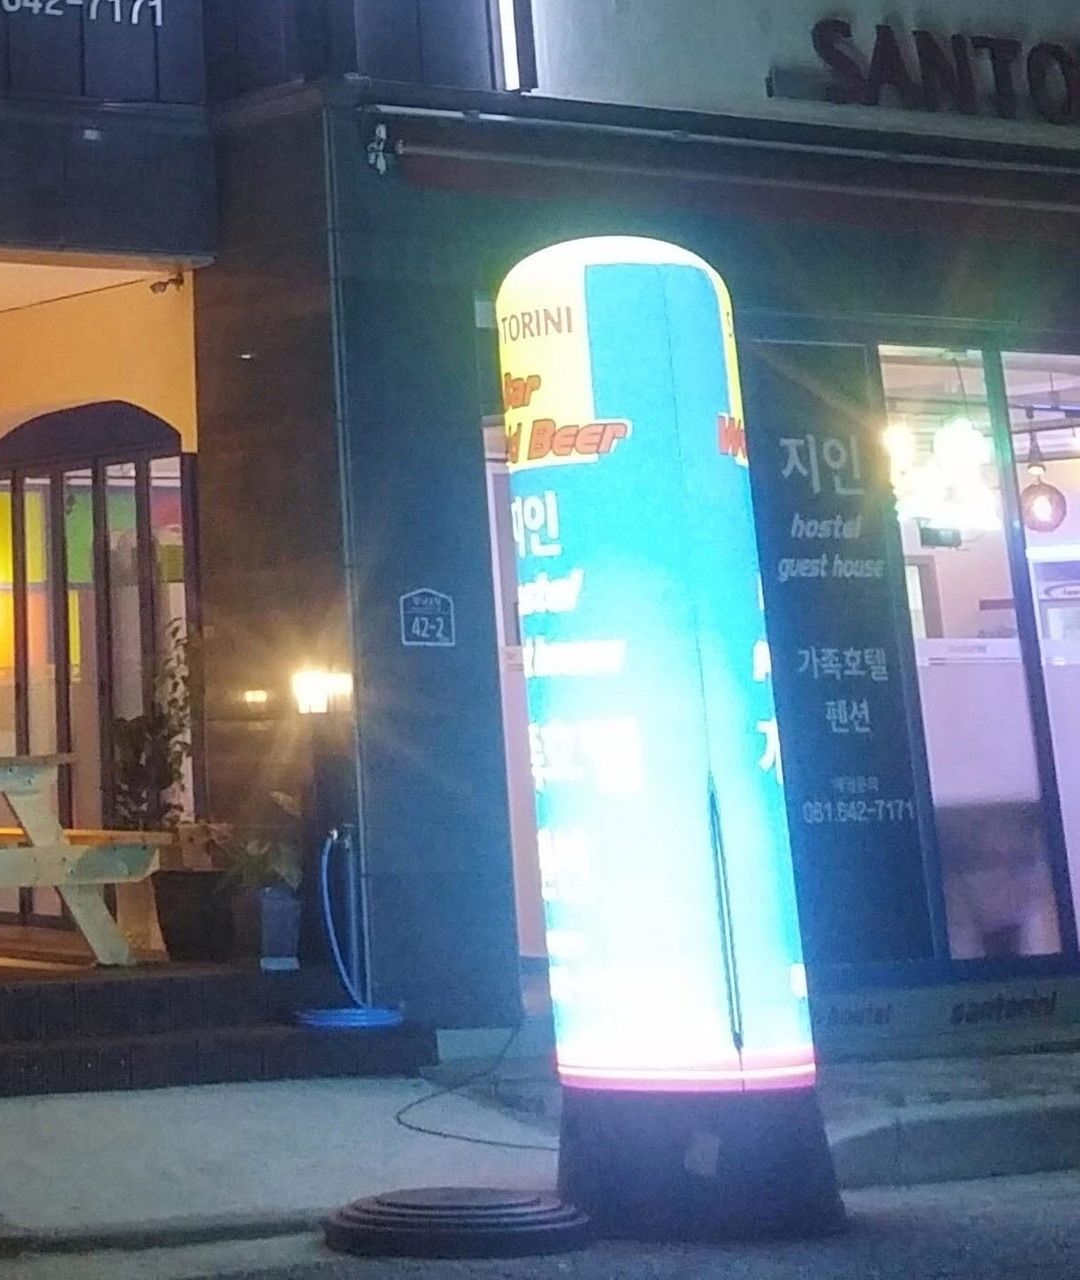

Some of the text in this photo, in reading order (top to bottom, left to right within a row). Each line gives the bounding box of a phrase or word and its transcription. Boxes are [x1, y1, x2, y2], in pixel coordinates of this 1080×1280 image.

[527, 418, 628, 461] Beer
[779, 432, 866, 495] 지인
[791, 512, 863, 539] hostel
[778, 553, 886, 583] guest house
[798, 646, 889, 681] 가족호텔
[825, 699, 871, 733] 펜션
